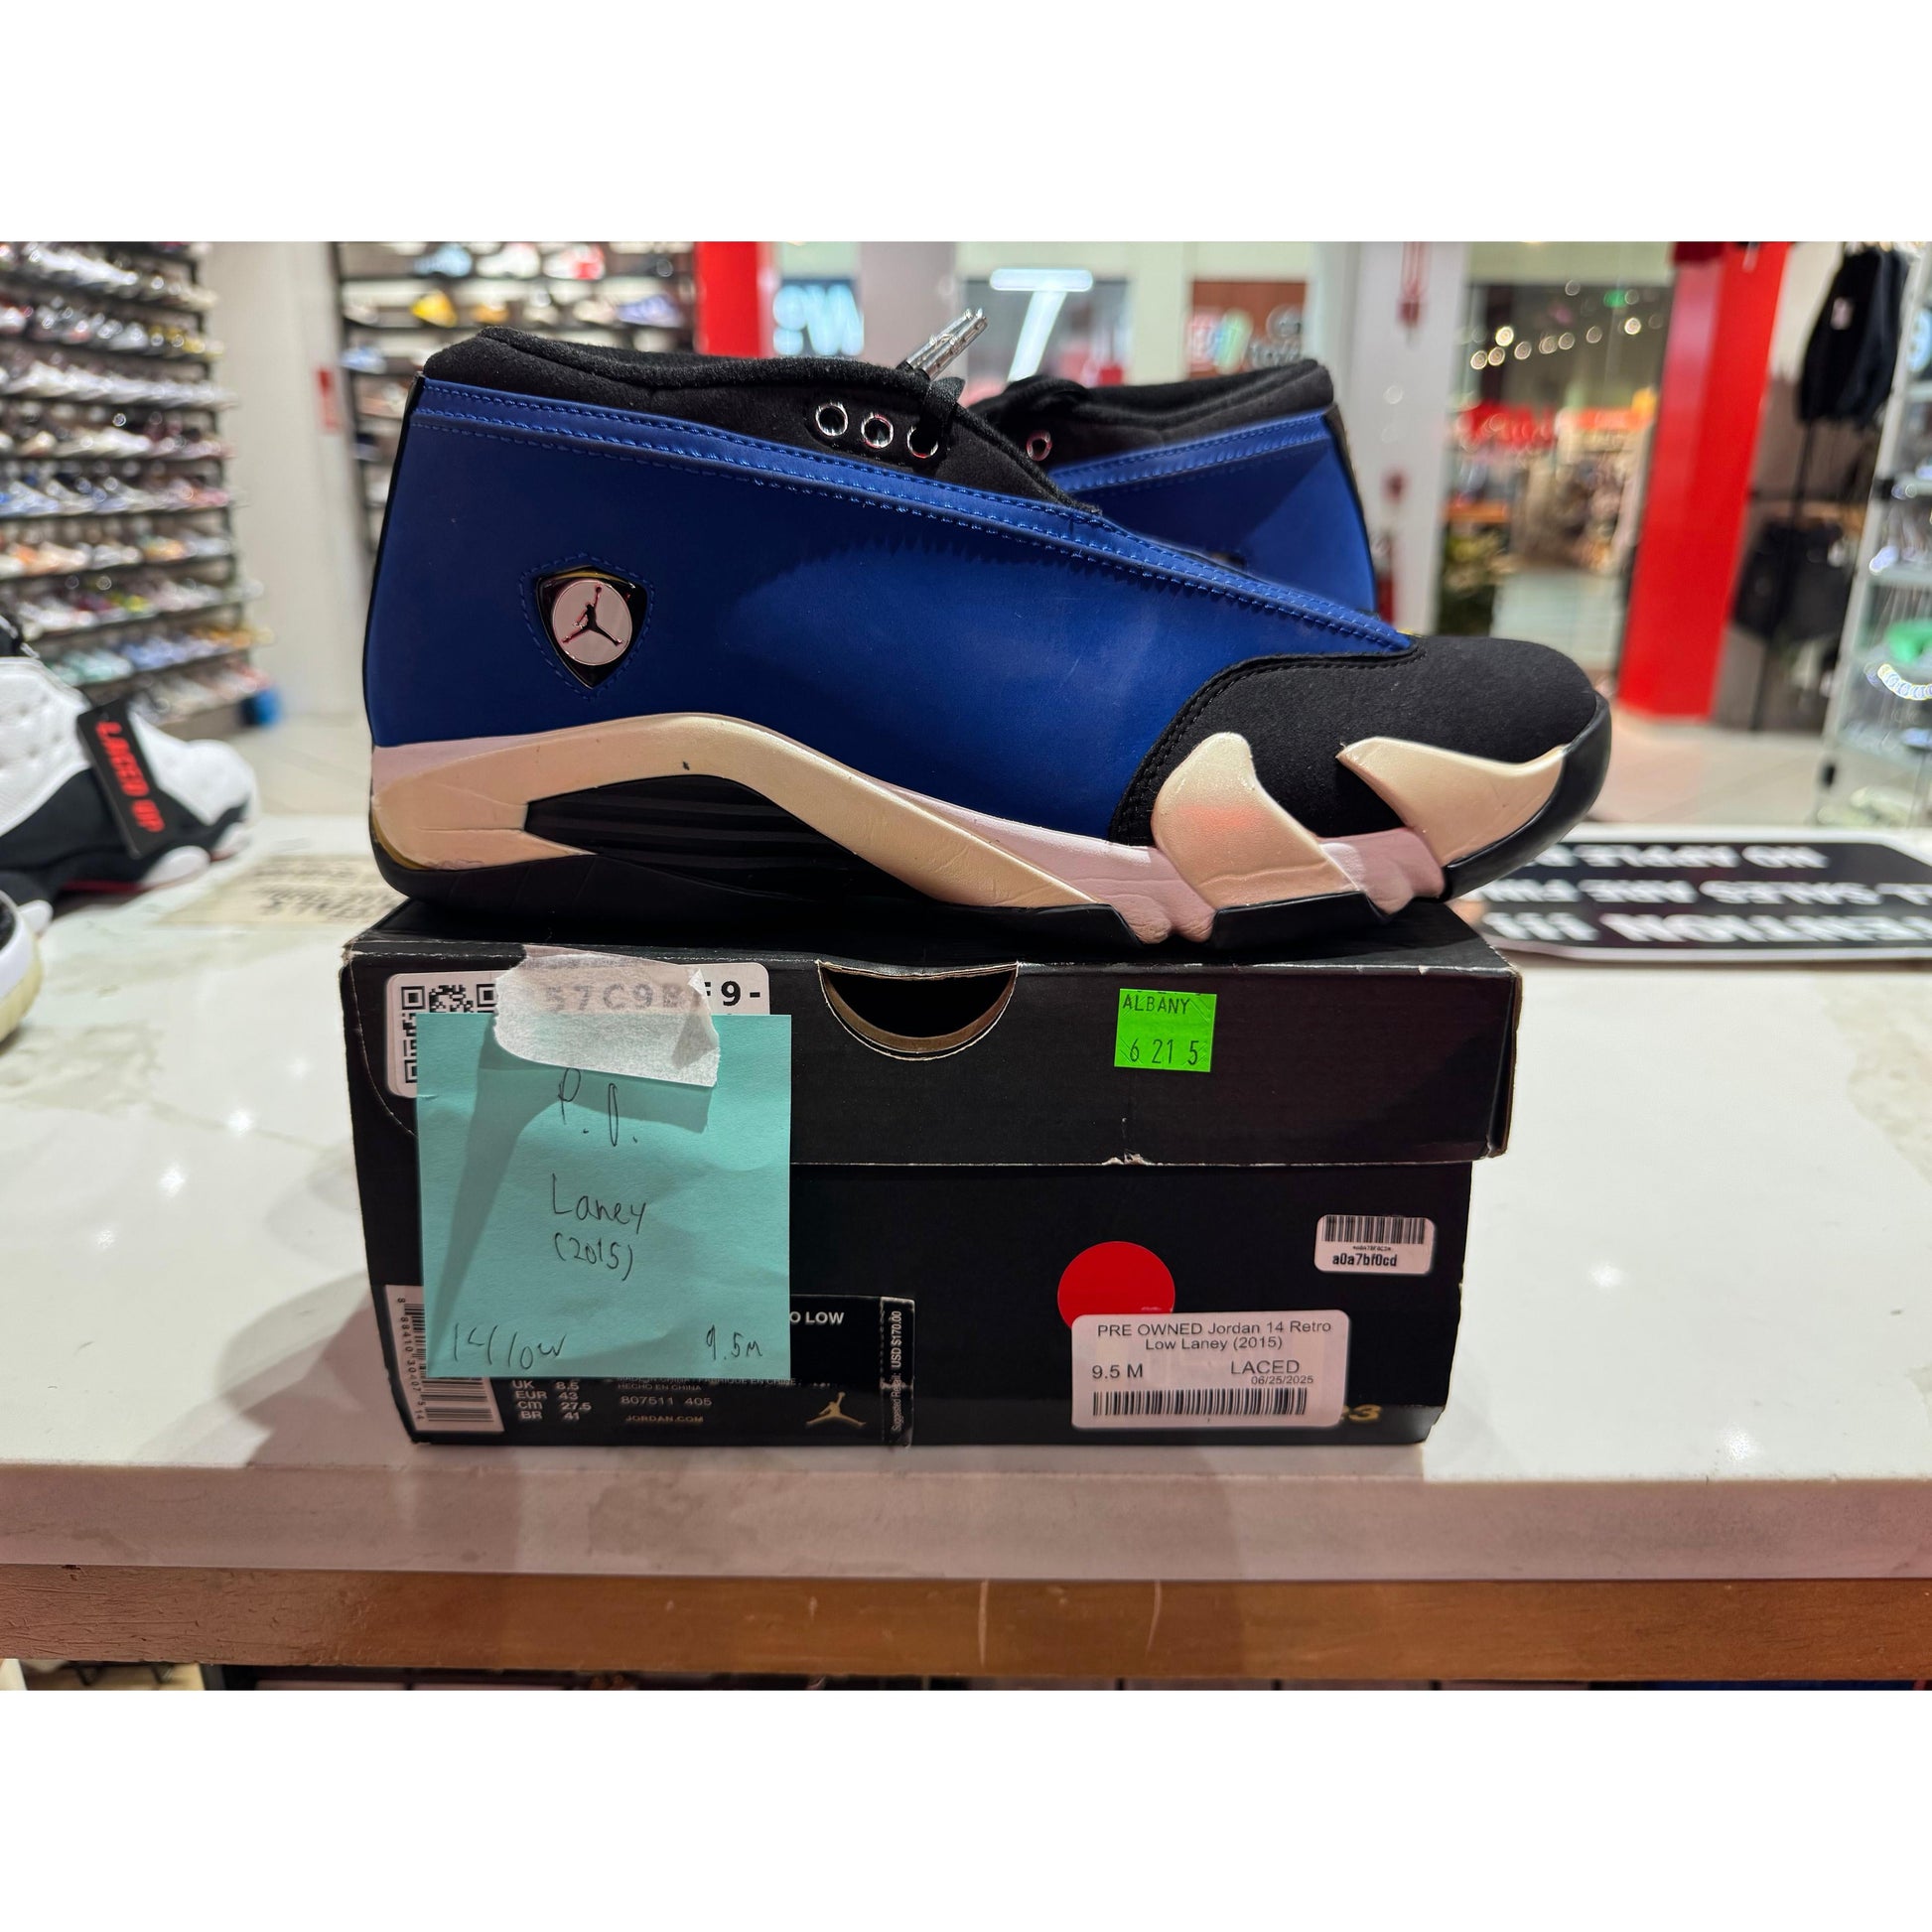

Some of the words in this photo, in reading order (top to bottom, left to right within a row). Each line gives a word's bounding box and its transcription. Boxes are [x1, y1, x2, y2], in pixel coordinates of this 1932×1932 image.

[1122, 994, 1190, 1015] ALBANY
[1129, 1037, 1140, 1063] 6
[1186, 1039, 1199, 1065] 5
[551, 1173, 646, 1234] Laney
[554, 1232, 633, 1281] (2015)
[1332, 1252, 1398, 1267] a0a7bf0cd
[805, 1311, 844, 1324] LOW
[891, 1310, 902, 1346] $170.00
[1097, 1323, 1133, 1337] PRE
[1137, 1322, 1203, 1336] OWNED
[1207, 1321, 1261, 1335] Jordan
[1267, 1321, 1285, 1333] 14
[1290, 1319, 1332, 1333] Retro
[1145, 1338, 1176, 1350] Low
[1181, 1337, 1228, 1351] Laney
[1233, 1335, 1284, 1351] (2015)
[891, 1348, 902, 1369] USD
[1091, 1364, 1121, 1379] 9.5
[1126, 1362, 1144, 1378] M
[1230, 1359, 1301, 1375] LACED
[511, 1379, 534, 1390] UK
[555, 1381, 580, 1391] 8.5
[1250, 1375, 1314, 1385] 06/25/2025
[514, 1390, 547, 1400] EUR
[558, 1391, 579, 1401] 43
[620, 1395, 674, 1407] 807511
[684, 1397, 713, 1407] 405
[560, 1402, 592, 1412] 27.5
[519, 1411, 543, 1421] BR
[563, 1412, 581, 1421] 41
[625, 1415, 704, 1424] JORDAN.COM
